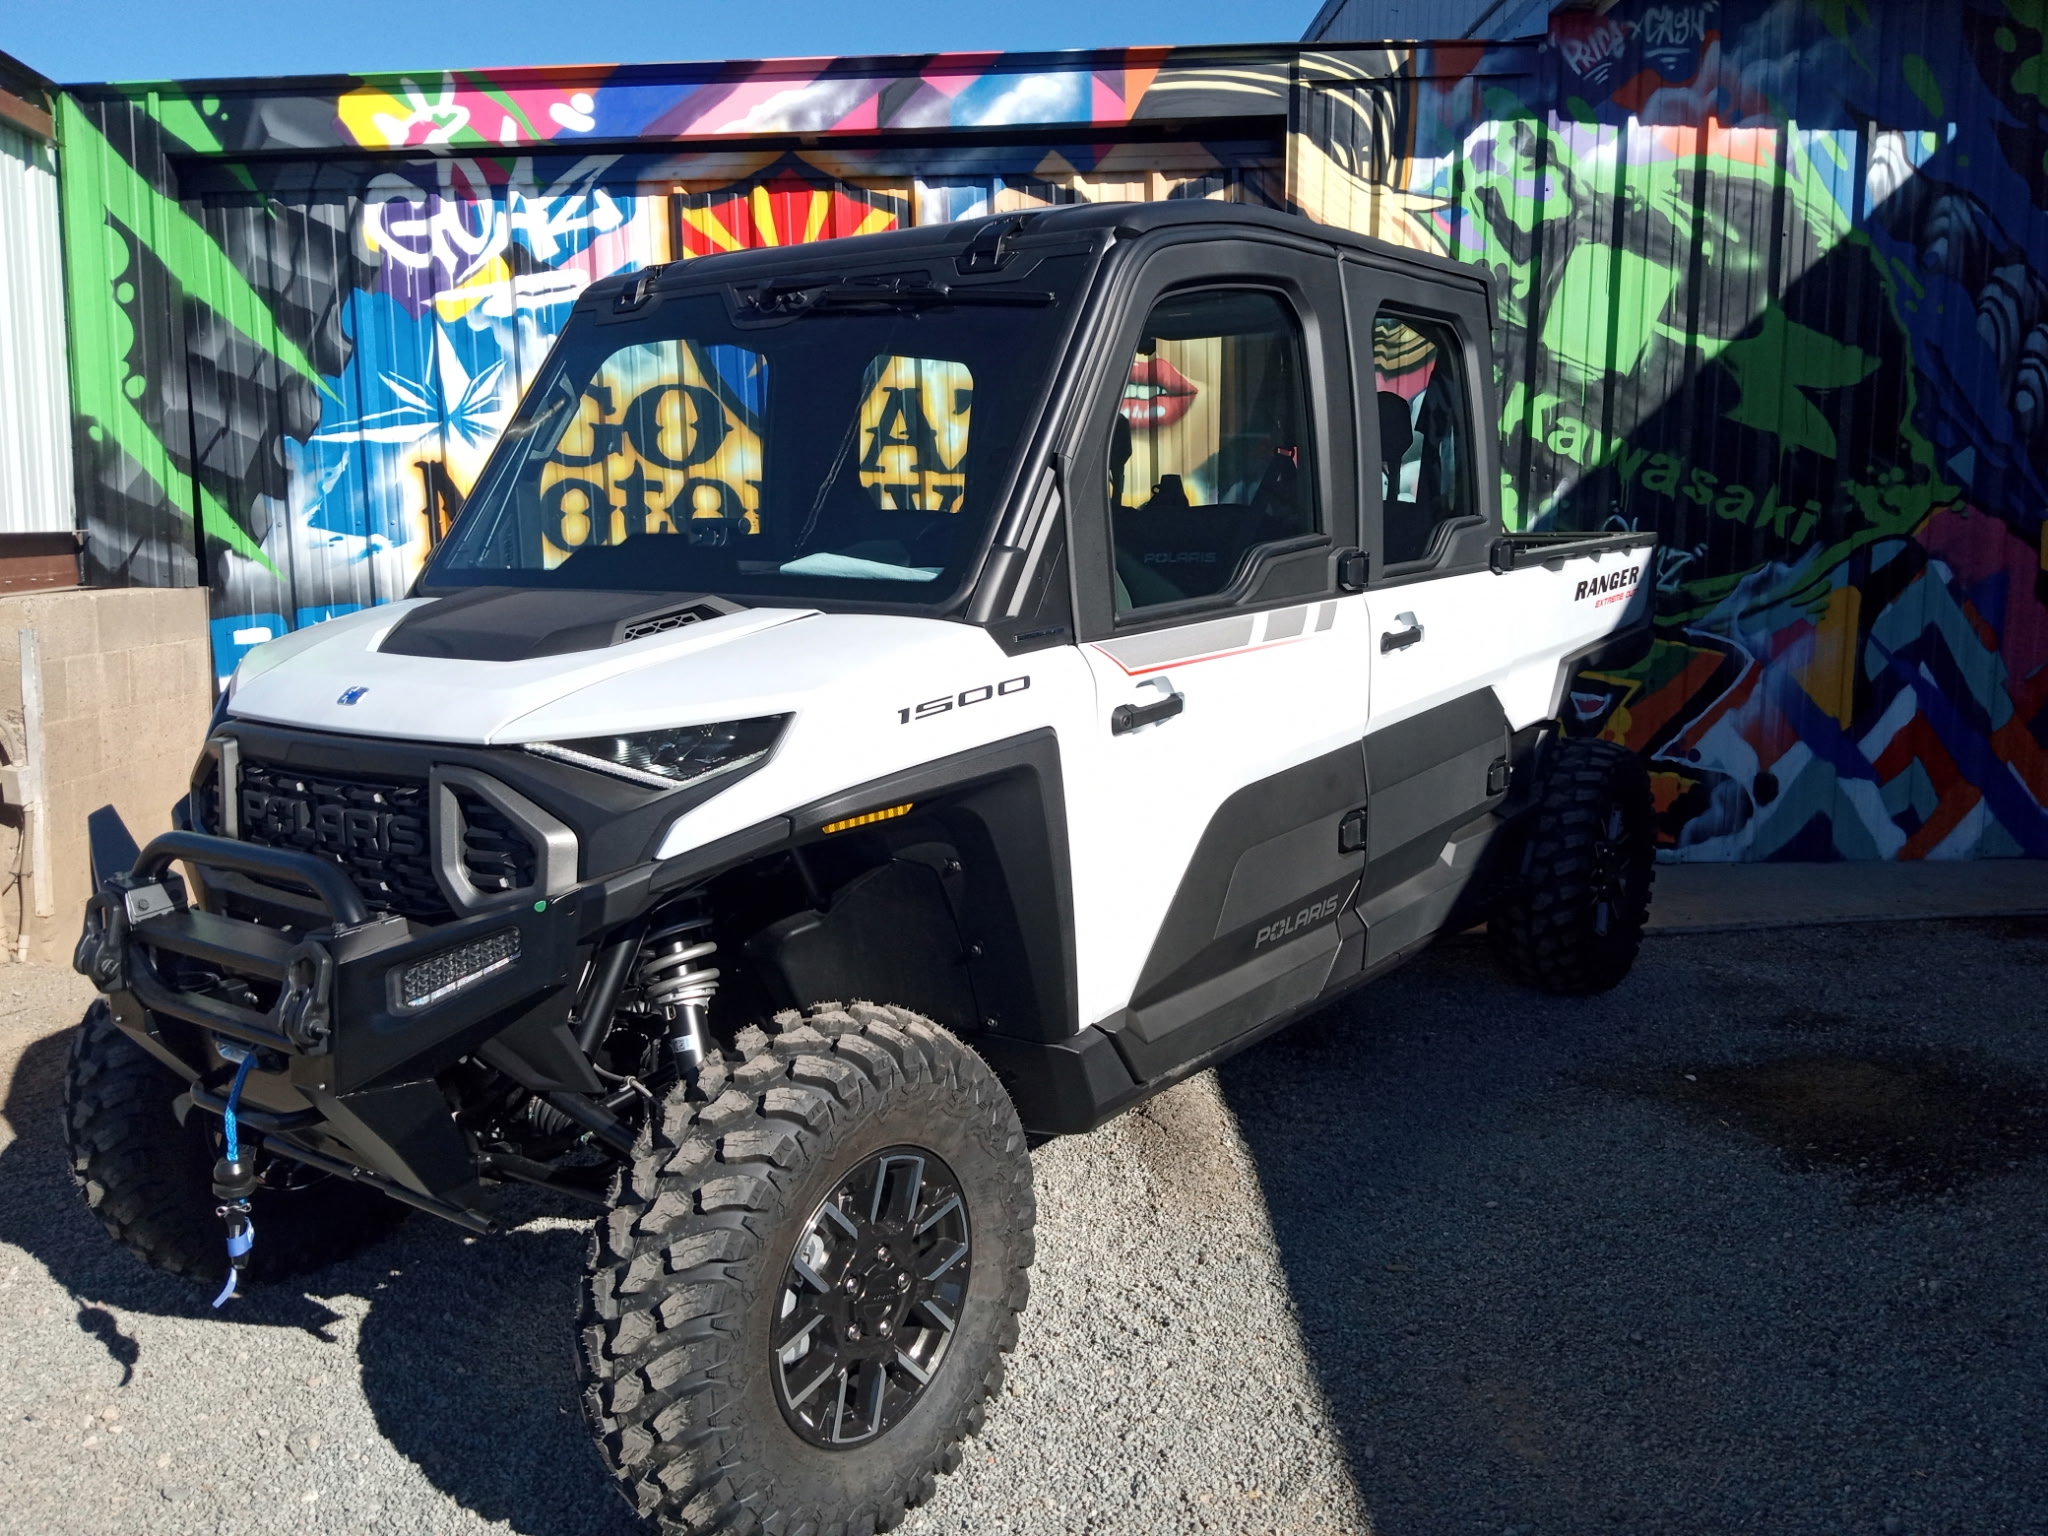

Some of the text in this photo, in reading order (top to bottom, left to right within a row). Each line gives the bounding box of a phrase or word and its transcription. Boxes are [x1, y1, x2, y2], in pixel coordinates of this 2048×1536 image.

[1143, 552, 1217, 563] POLARIS
[1574, 566, 1640, 601] RANGER
[898, 675, 1031, 724] 1500
[243, 789, 424, 855] POLARIS
[1254, 894, 1339, 949] POLARIS
